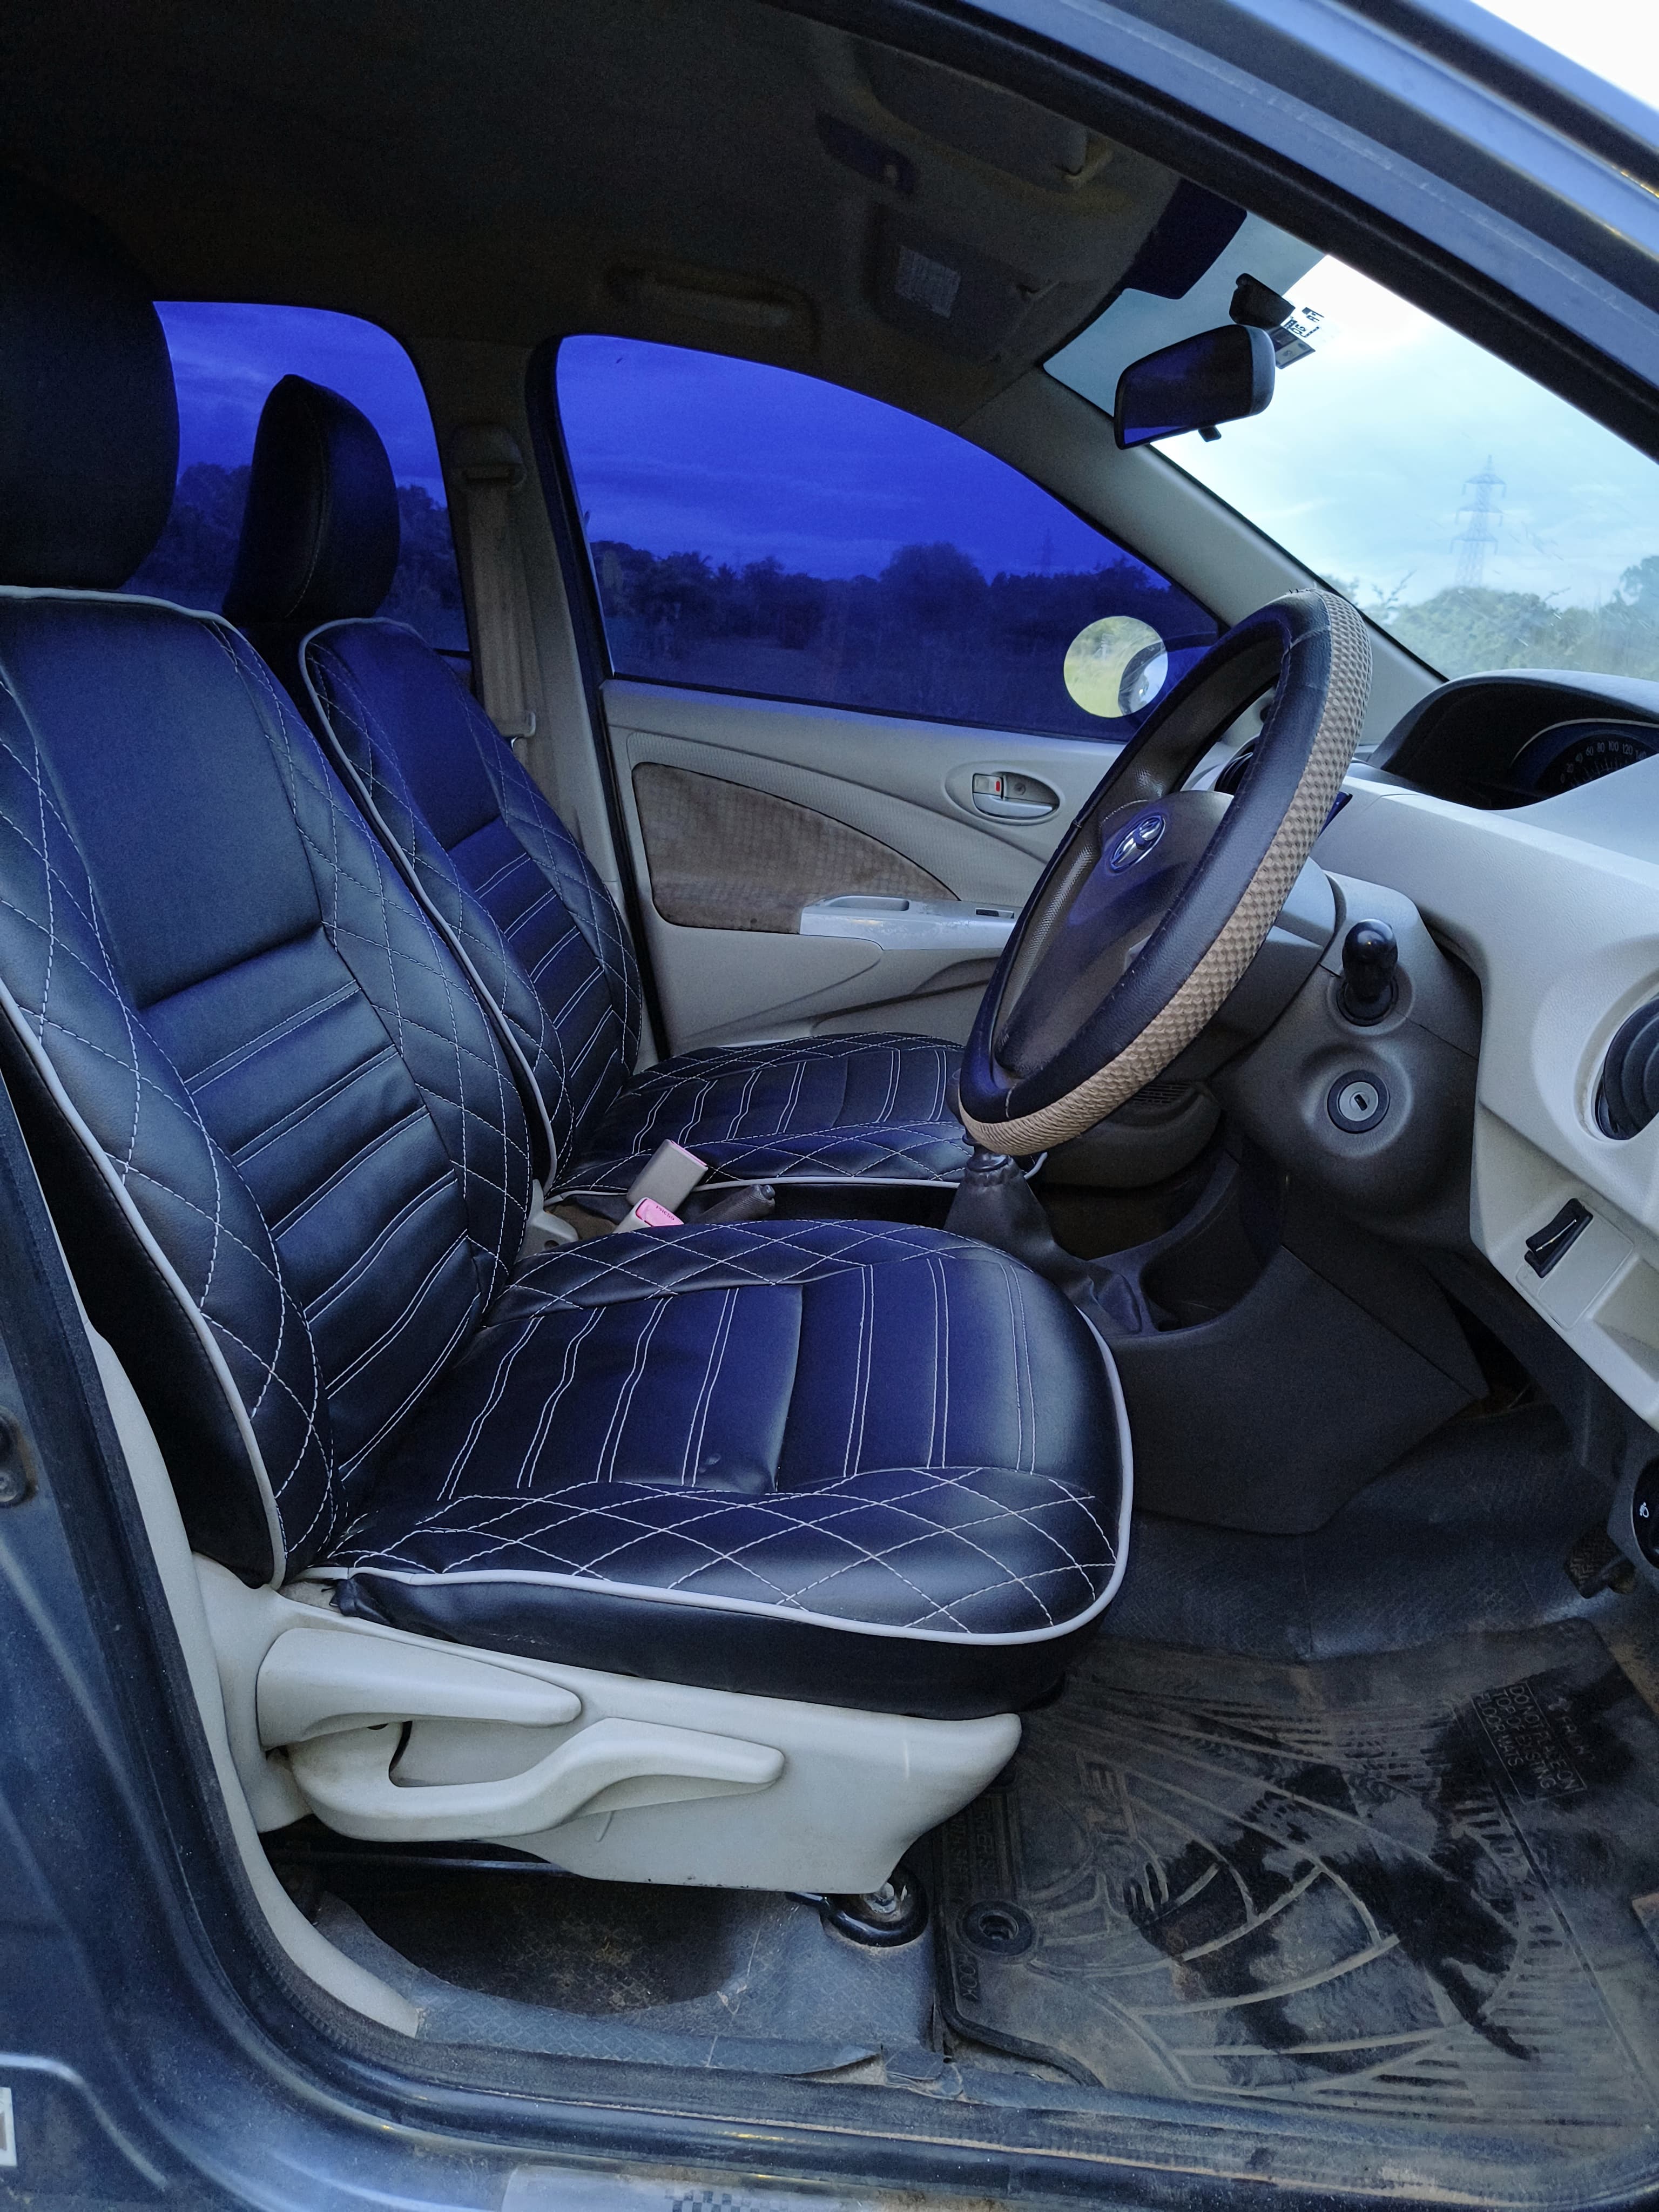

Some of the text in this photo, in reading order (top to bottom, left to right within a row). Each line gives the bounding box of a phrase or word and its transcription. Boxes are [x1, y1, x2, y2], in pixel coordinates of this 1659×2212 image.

[1586, 746, 1594, 756] 60
[1597, 742, 1605, 752] 80
[1608, 740, 1619, 752] 100
[1622, 744, 1633, 755] 120
[1509, 1685, 1530, 1704] DO
[1493, 1689, 1516, 1714] TOP
[1507, 1716, 1525, 1731] OF
[1519, 1705, 1545, 1728] NOT
[1476, 1692, 1524, 1766] FLOOR MATS
[1557, 1771, 1579, 1789] ON
